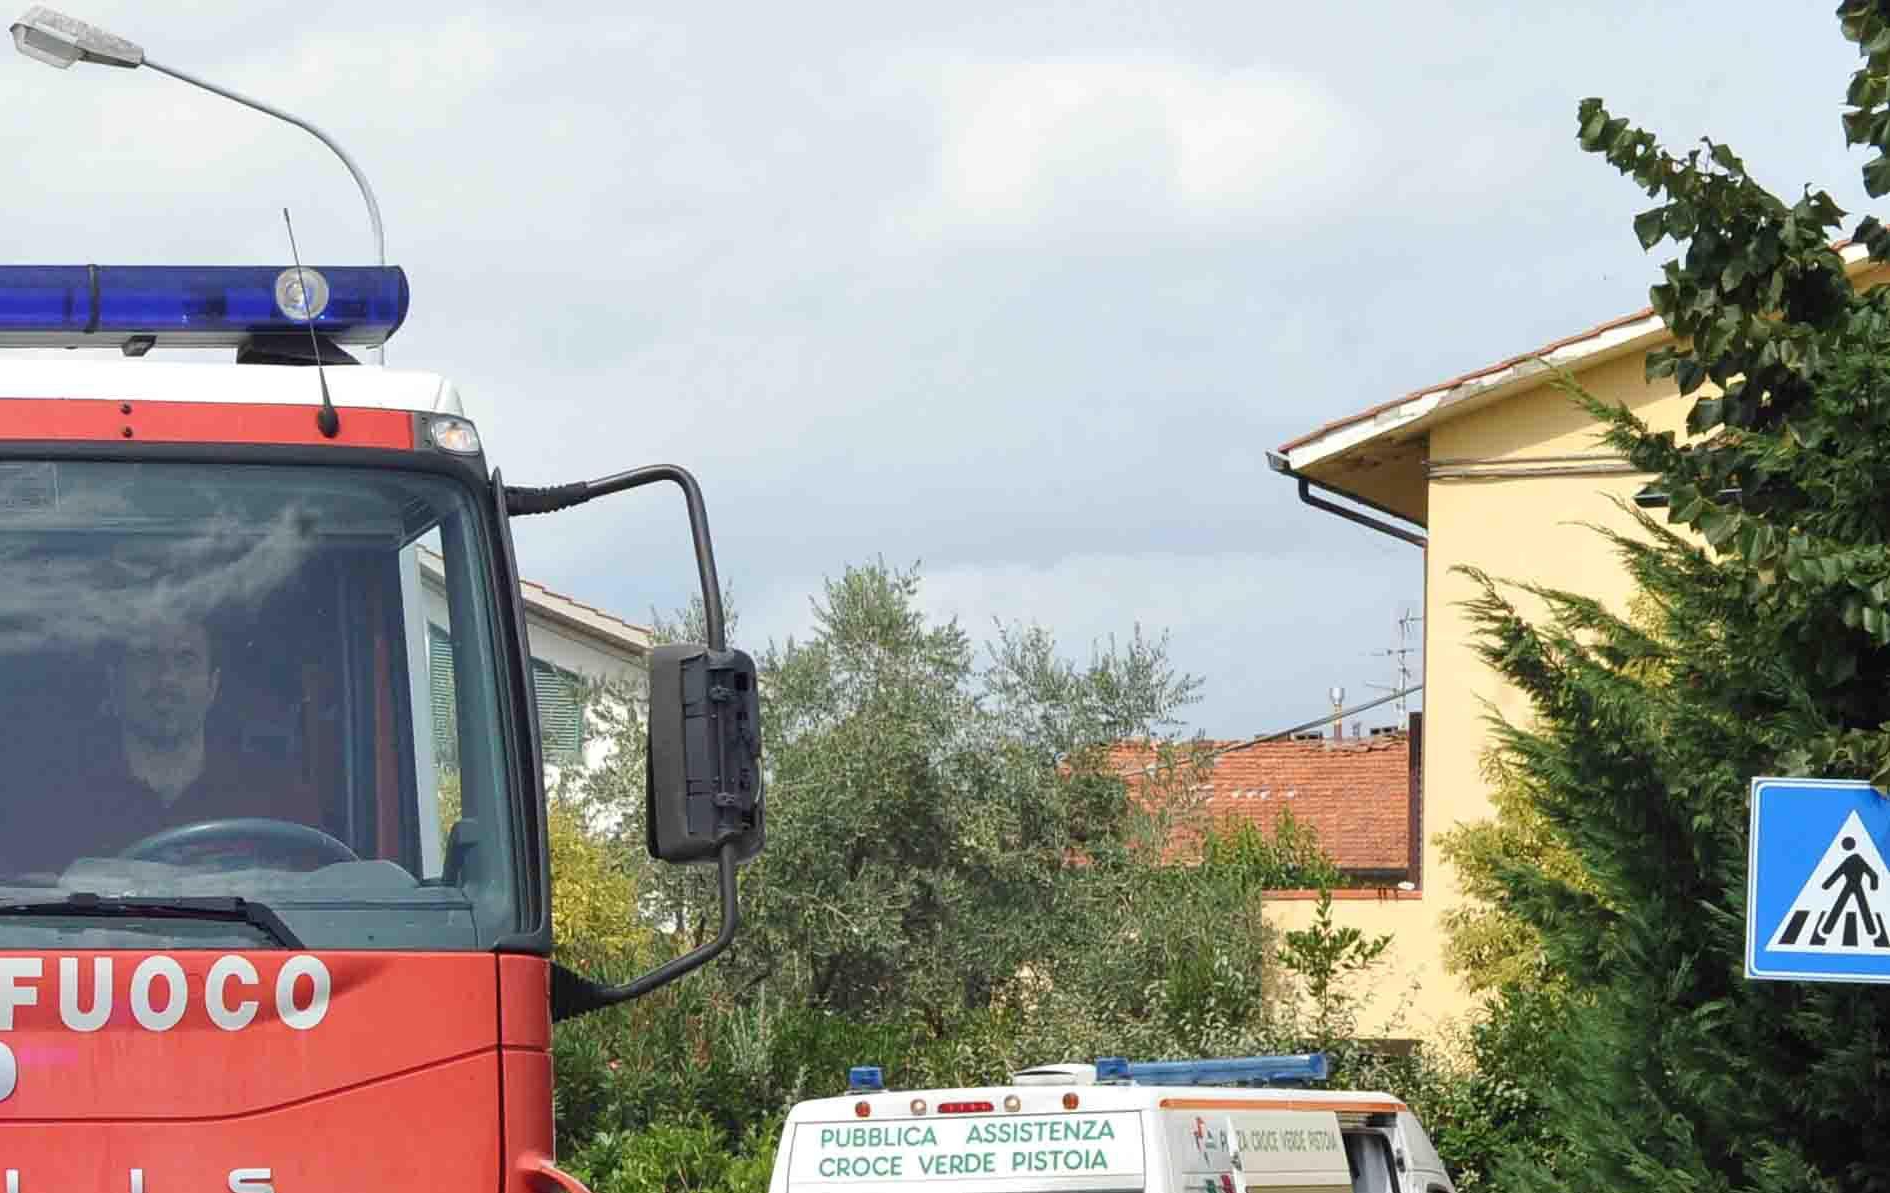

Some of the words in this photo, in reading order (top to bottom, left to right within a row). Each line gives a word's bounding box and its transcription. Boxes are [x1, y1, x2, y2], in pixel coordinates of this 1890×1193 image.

[820, 1125, 938, 1149] PUBBLICA
[966, 1119, 1116, 1145] ASSISTENZA
[818, 1155, 903, 1178] CROCE
[918, 1151, 996, 1175] VERDE
[1012, 1148, 1109, 1172] PISTOIA
